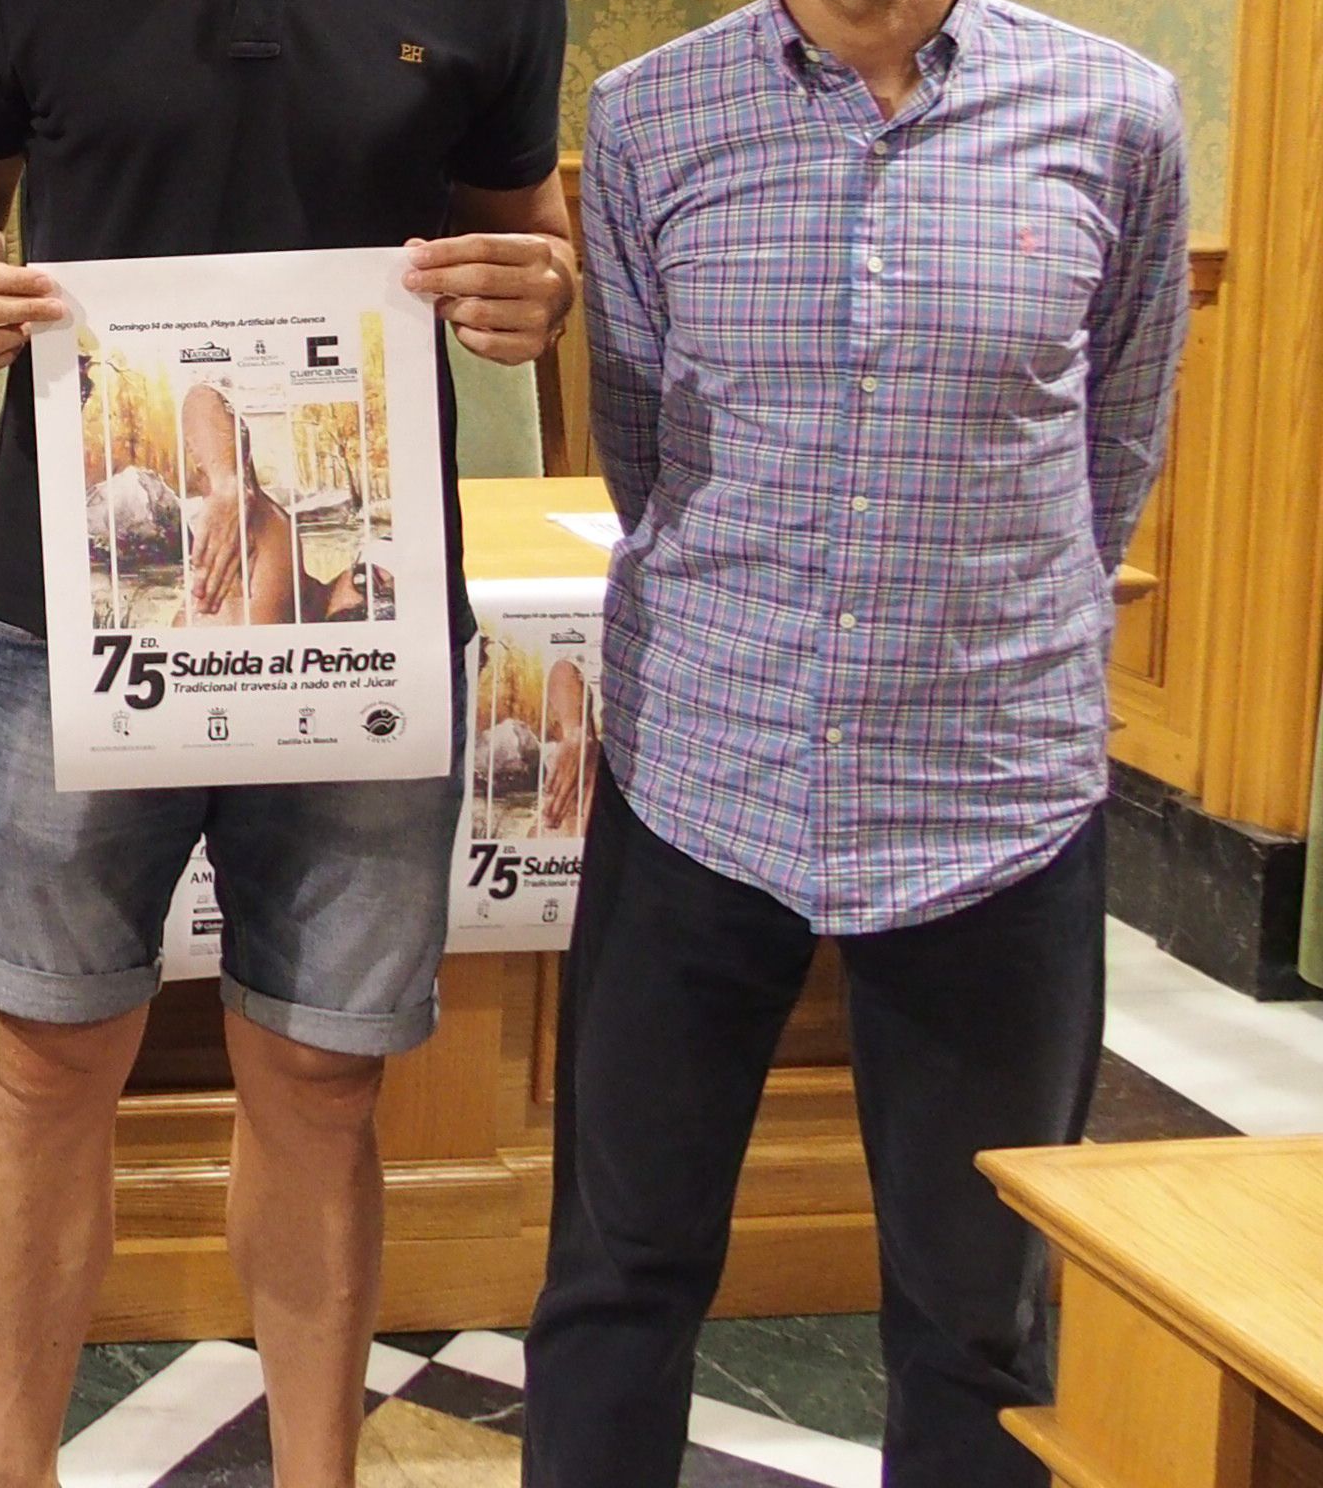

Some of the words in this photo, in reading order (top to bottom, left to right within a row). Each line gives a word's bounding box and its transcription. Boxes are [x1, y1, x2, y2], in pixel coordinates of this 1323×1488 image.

[109, 322, 151, 332] Domingo
[161, 321, 173, 329] de
[175, 321, 210, 331] agosto,
[211, 319, 236, 329] Playa
[237, 317, 276, 327] Artificial
[277, 317, 289, 325] de
[290, 315, 326, 325] Cuenca
[92, 634, 168, 710] 75
[140, 637, 160, 649] ED.
[170, 649, 263, 678] Subida
[268, 648, 295, 675] al
[300, 646, 397, 673] Peñote
[172, 681, 238, 694] Tradicional
[241, 680, 289, 692] travesía
[290, 683, 298, 691] a
[300, 679, 330, 690] nado
[333, 680, 347, 689] en
[349, 677, 361, 689] el
[363, 676, 398, 689] Júcar
[468, 844, 521, 900] 75
